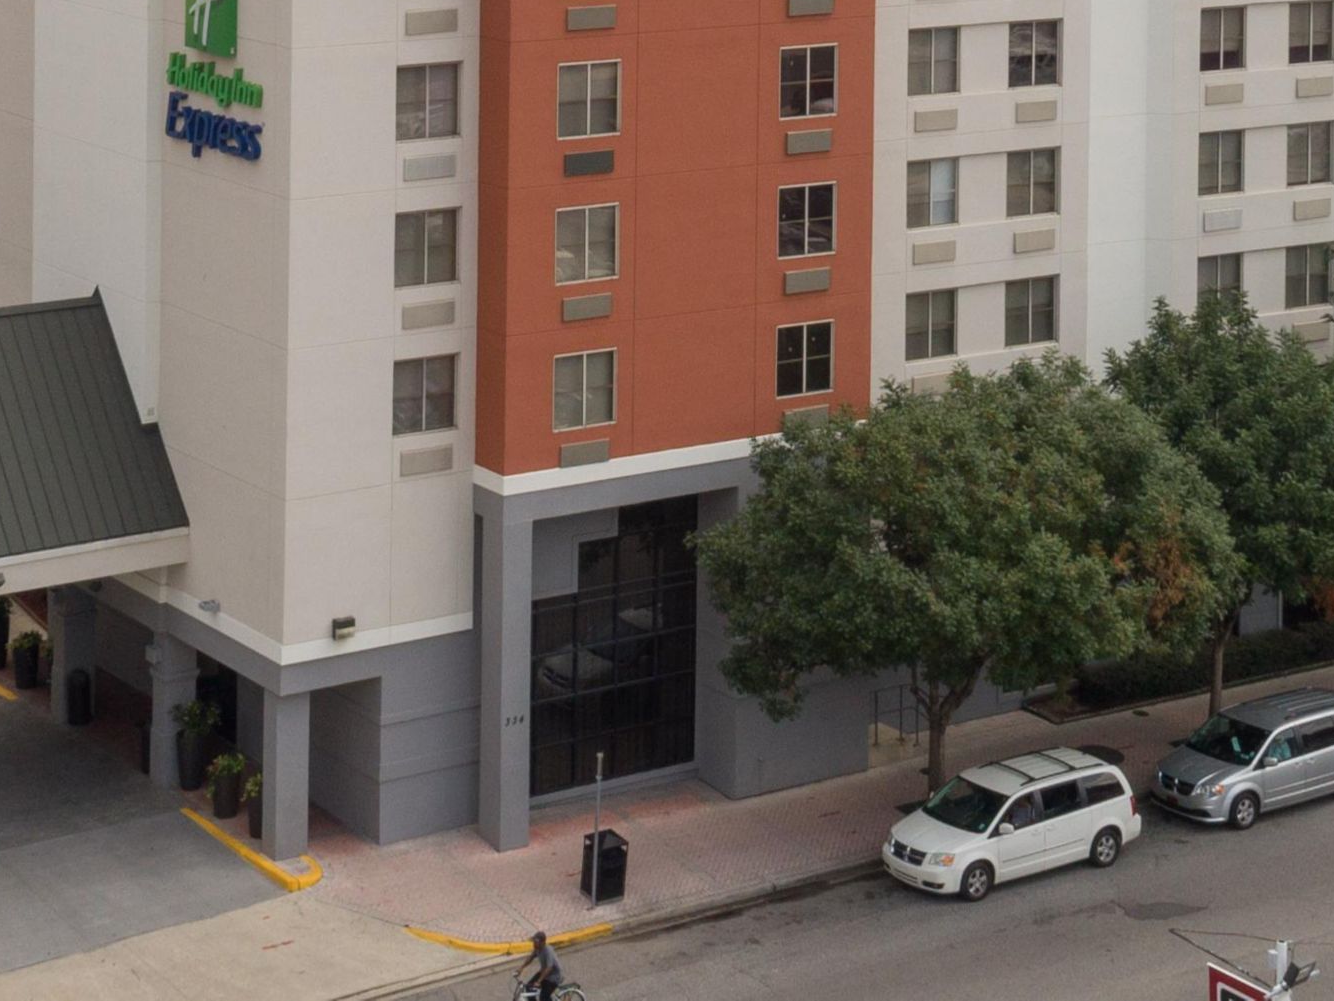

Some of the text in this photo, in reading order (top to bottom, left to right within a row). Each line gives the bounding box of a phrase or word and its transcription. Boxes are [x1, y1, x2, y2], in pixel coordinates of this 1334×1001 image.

[166, 51, 264, 109] Holiday Inn
[165, 90, 263, 162] Express
